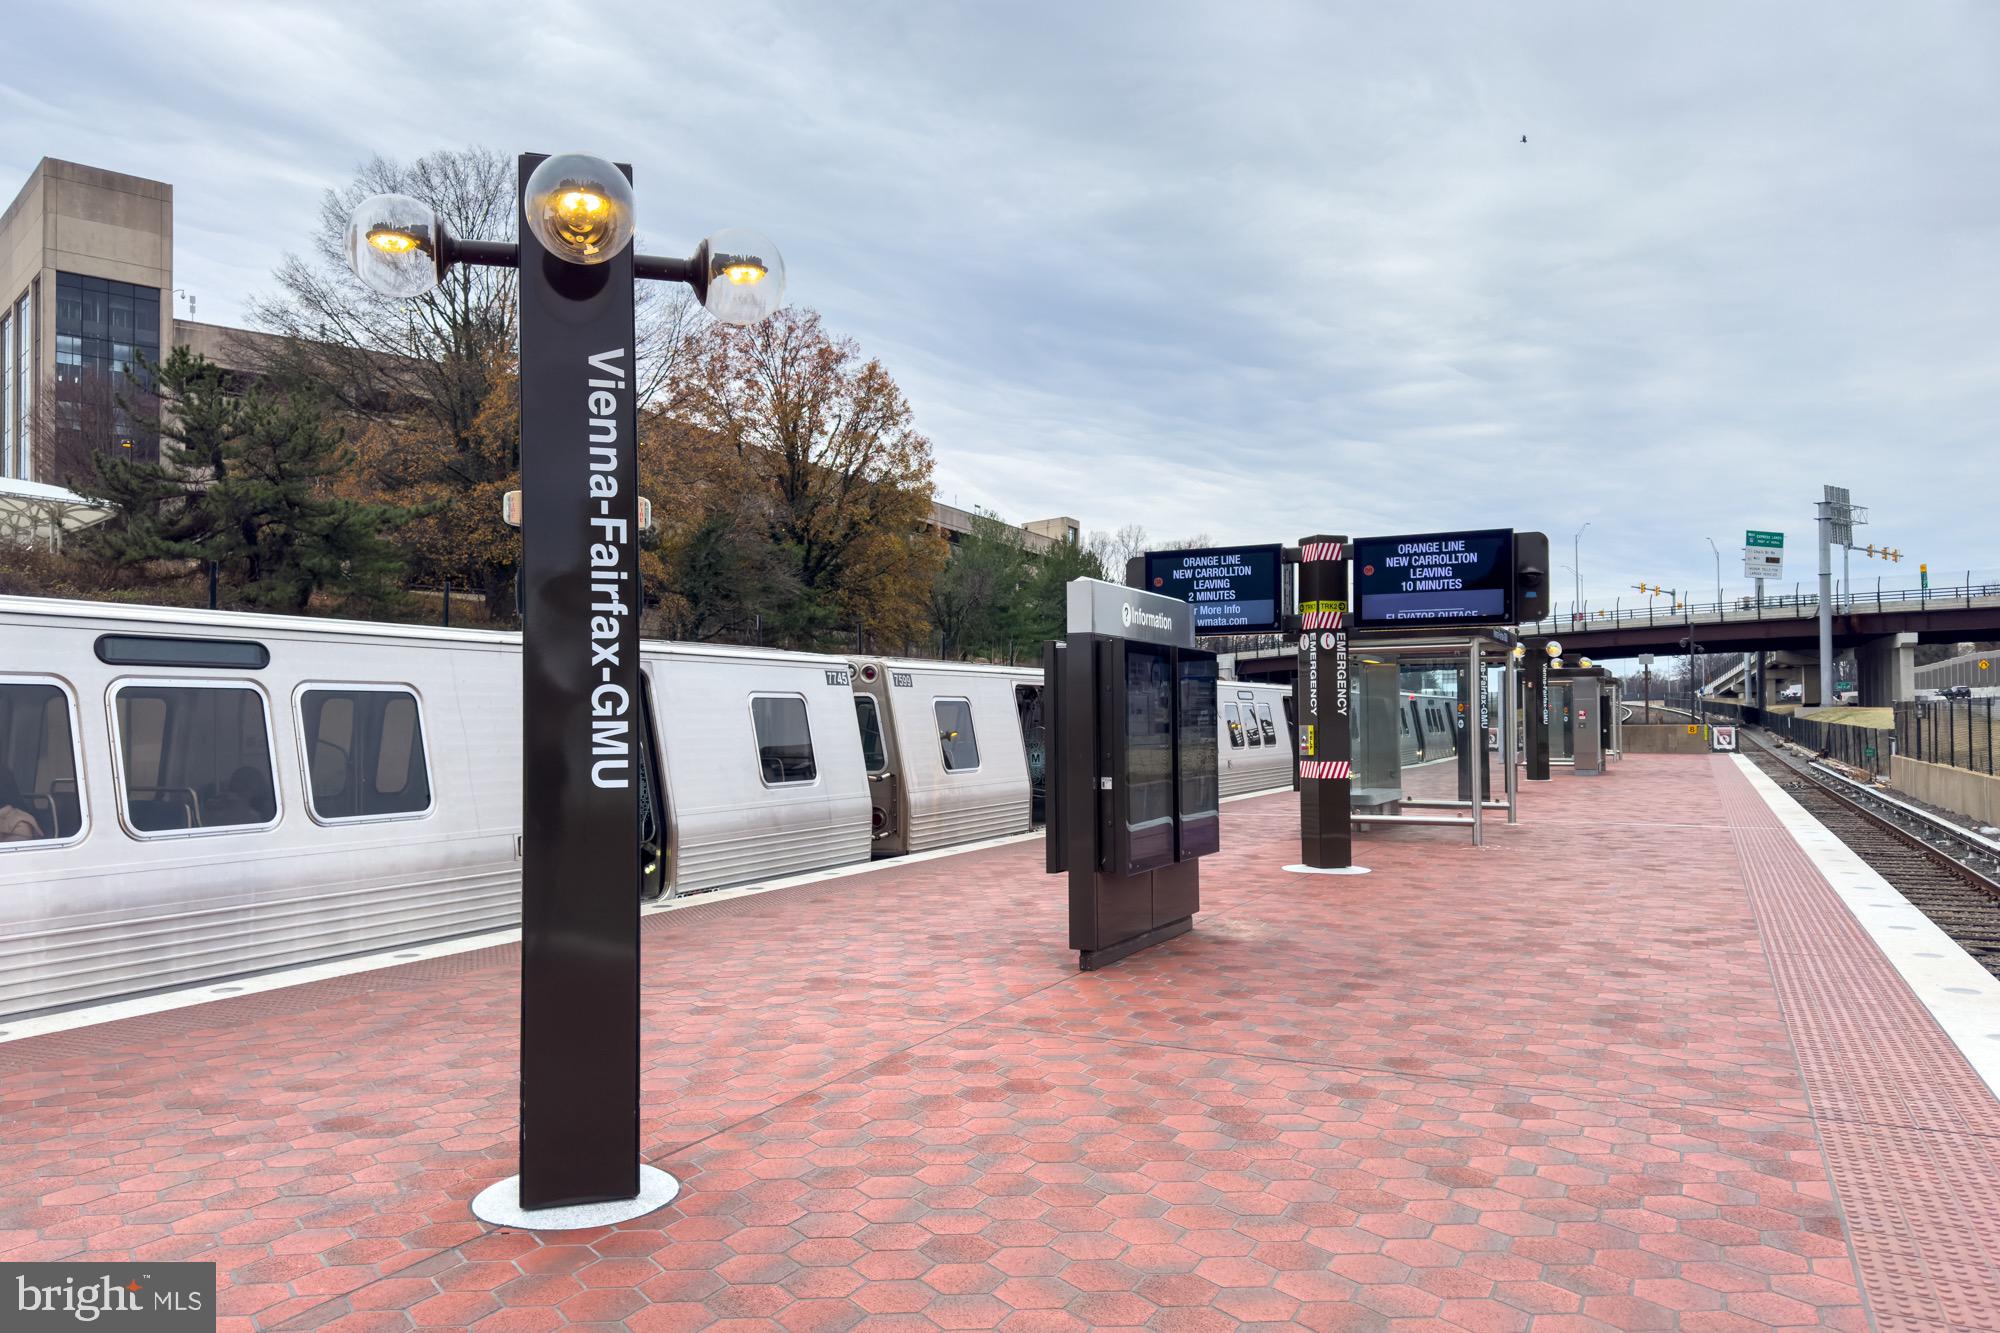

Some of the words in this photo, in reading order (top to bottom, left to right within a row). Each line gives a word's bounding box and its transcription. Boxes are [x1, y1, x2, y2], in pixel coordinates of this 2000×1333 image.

[1398, 543, 1439, 554] ORANGE
[1442, 541, 1465, 551] LINE
[1183, 556, 1219, 567] ORANGE
[1221, 555, 1241, 565] LINE
[1386, 557, 1409, 567] NEW
[1412, 553, 1478, 566] CARROLLTON
[588, 347, 629, 788] Vienna-Fairfax-GMU
[1173, 569, 1193, 579] NEW
[1195, 566, 1251, 578] CARROLLTON
[1410, 567, 1452, 579] LEAVING
[1194, 579, 1230, 589] LEAVING
[1401, 582, 1413, 592] 10
[1416, 579, 1463, 591] MINUTES
[1188, 592, 1194, 601] 2
[1197, 590, 1235, 601] MINUTES
[1200, 606, 1221, 615] More
[1224, 605, 1241, 614] Info
[1132, 607, 1172, 630] Information
[1197, 617, 1248, 627] wmata.com
[827, 672, 848, 685] 7745
[894, 674, 911, 686] 7599
[1309, 632, 1317, 716] EMERGENCY
[1337, 632, 1347, 716] EMERGENCY
